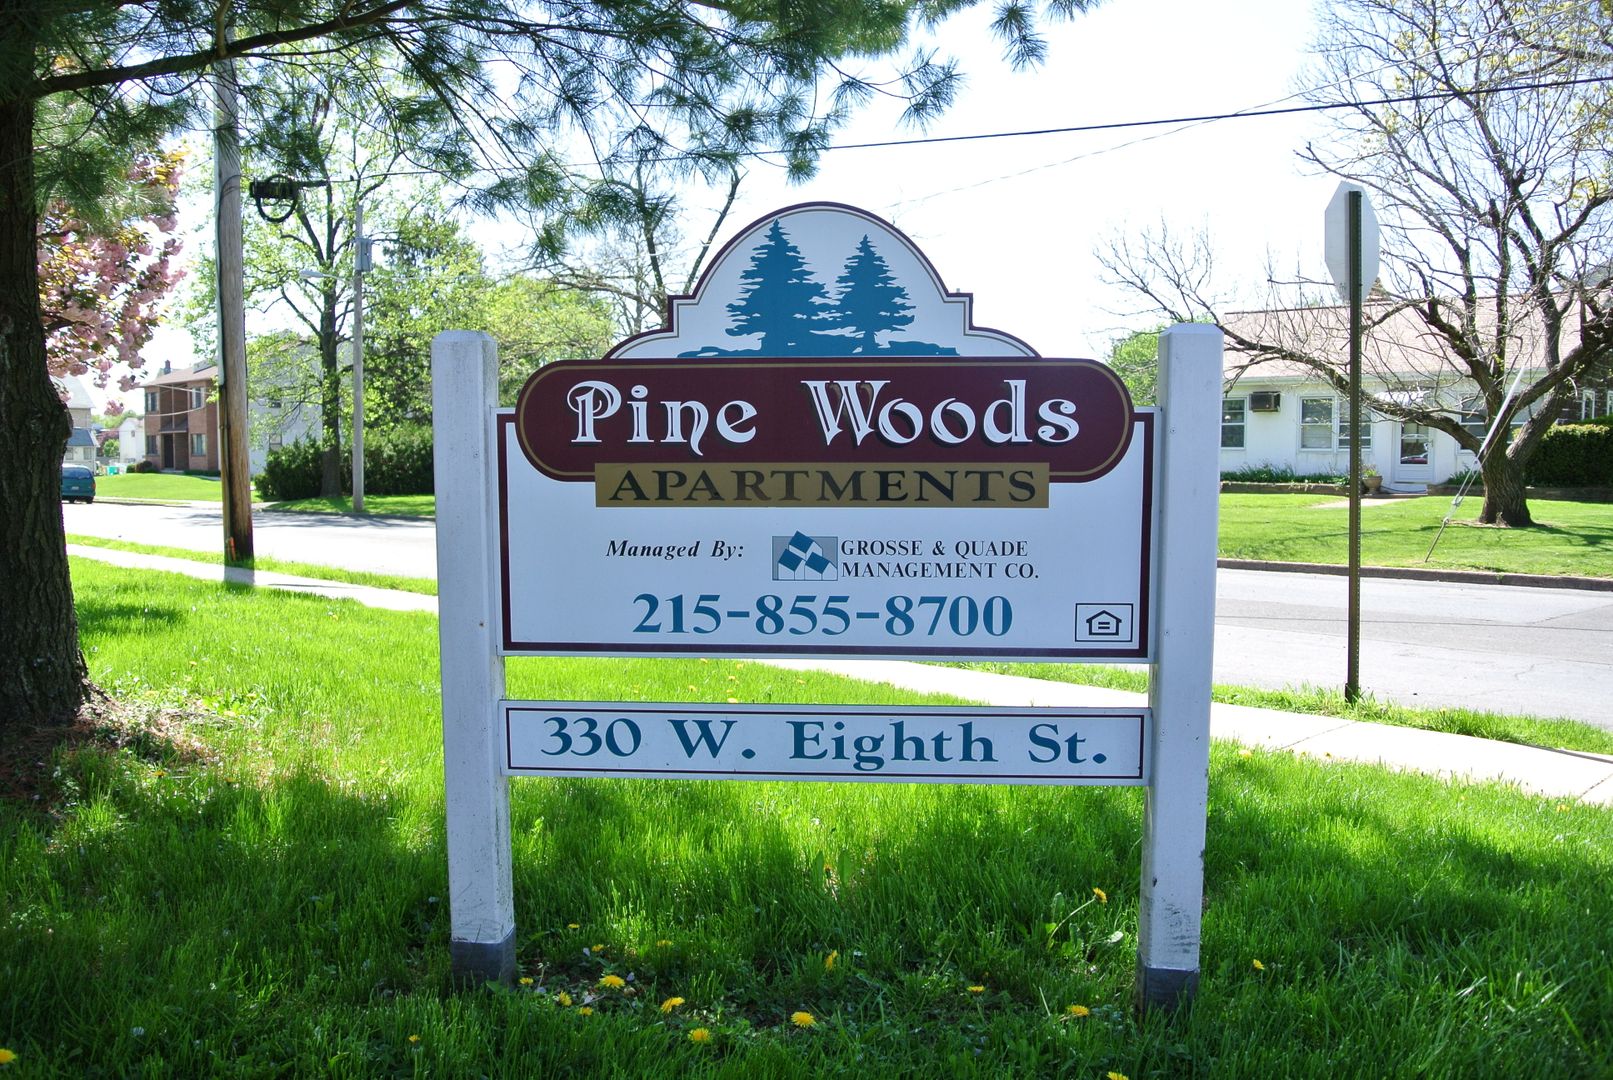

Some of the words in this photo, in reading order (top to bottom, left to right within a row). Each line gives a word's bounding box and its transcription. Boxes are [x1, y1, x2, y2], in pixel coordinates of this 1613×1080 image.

[566, 380, 758, 456] Pine
[801, 379, 1080, 446] Woods
[610, 470, 1036, 502] APARTMENTS
[606, 540, 700, 560] Managed
[711, 540, 744, 560] By:
[841, 540, 923, 557] GROSSE
[932, 540, 945, 557] &
[955, 540, 1028, 559] QUADE
[841, 562, 996, 578] MANAGEMENT
[1004, 562, 1039, 579] CO.
[632, 594, 1013, 636] 215-855-8700
[540, 717, 642, 756] 330
[668, 720, 756, 759] W.
[786, 720, 998, 771] Eighth
[1027, 723, 1107, 764] St.
